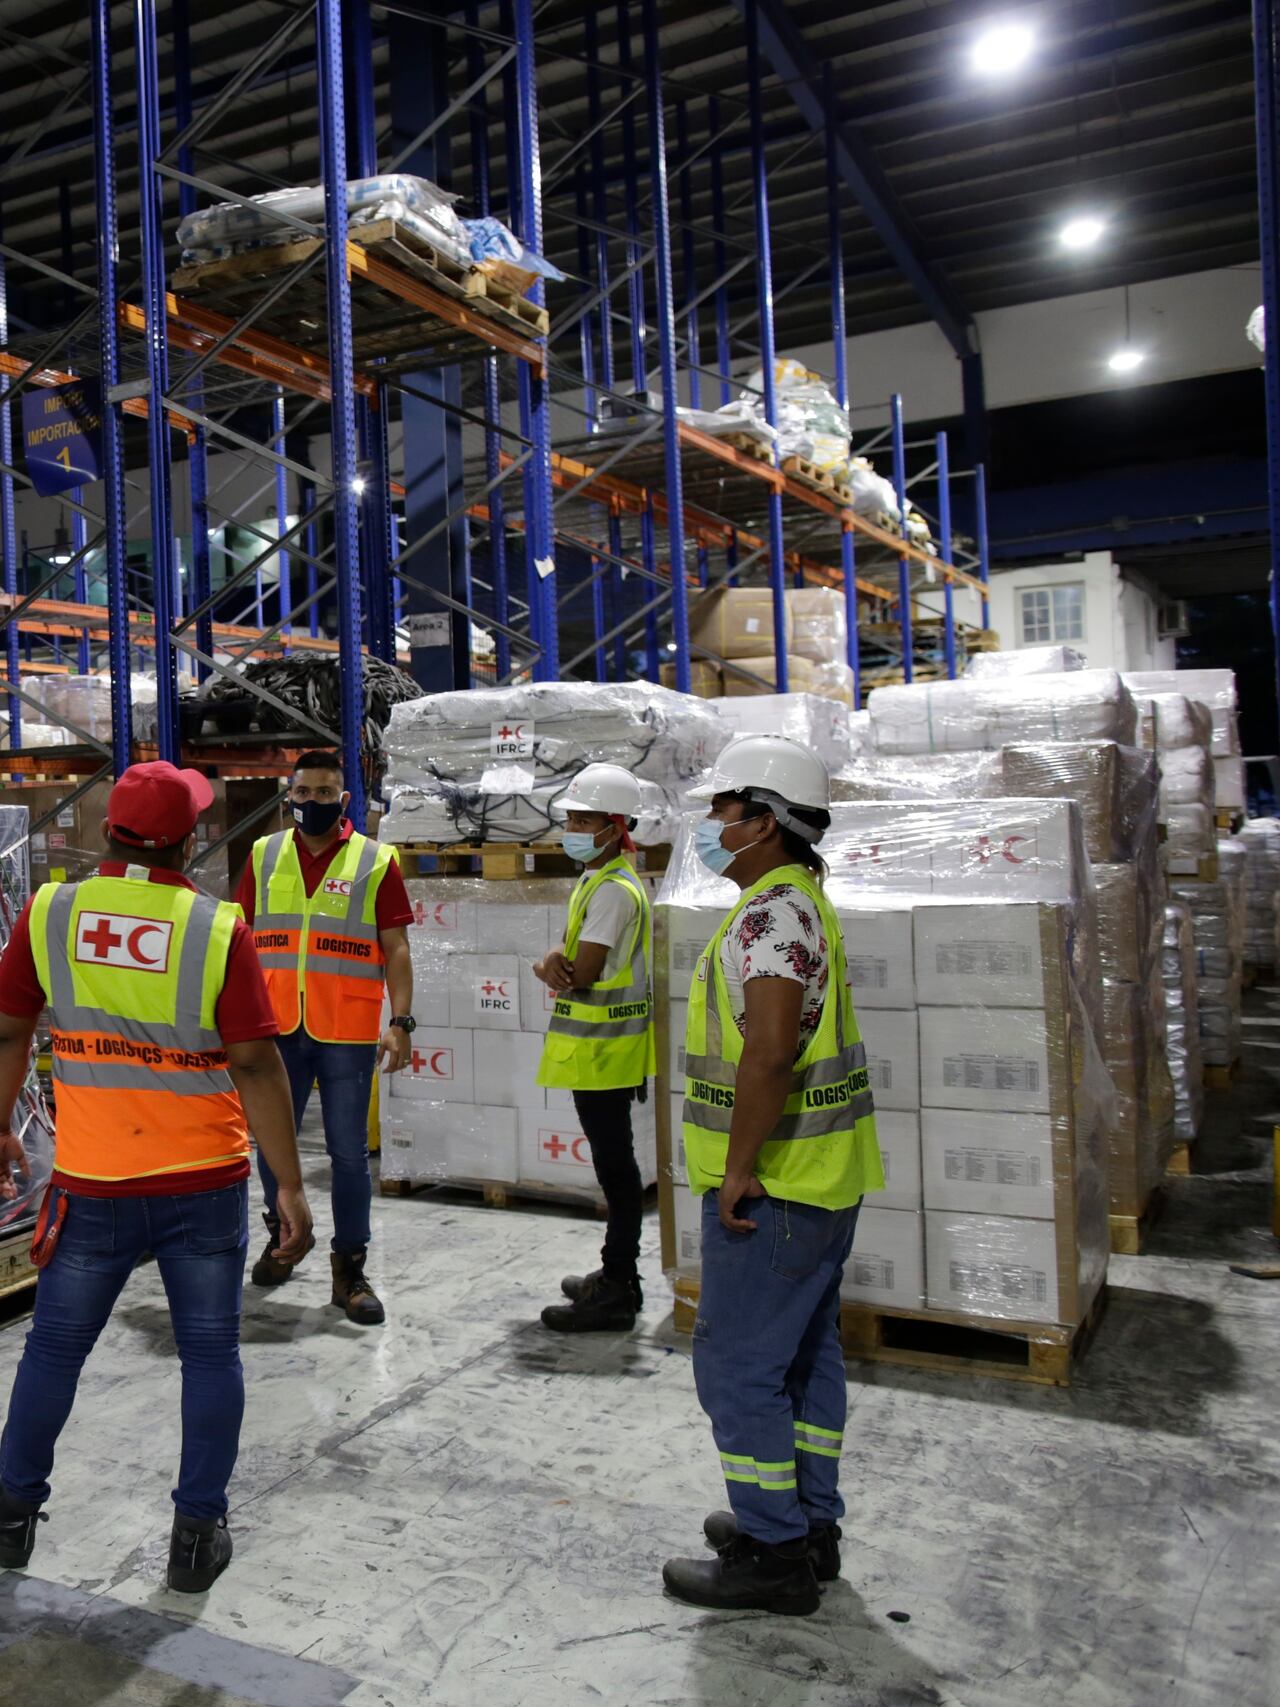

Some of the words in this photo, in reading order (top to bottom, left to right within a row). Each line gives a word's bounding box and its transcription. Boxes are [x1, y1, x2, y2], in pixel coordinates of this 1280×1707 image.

[56, 446, 71, 472] 1
[497, 744, 526, 754] IFRC
[316, 937, 372, 957] LOGISTICS
[481, 999, 511, 1010] IFRC
